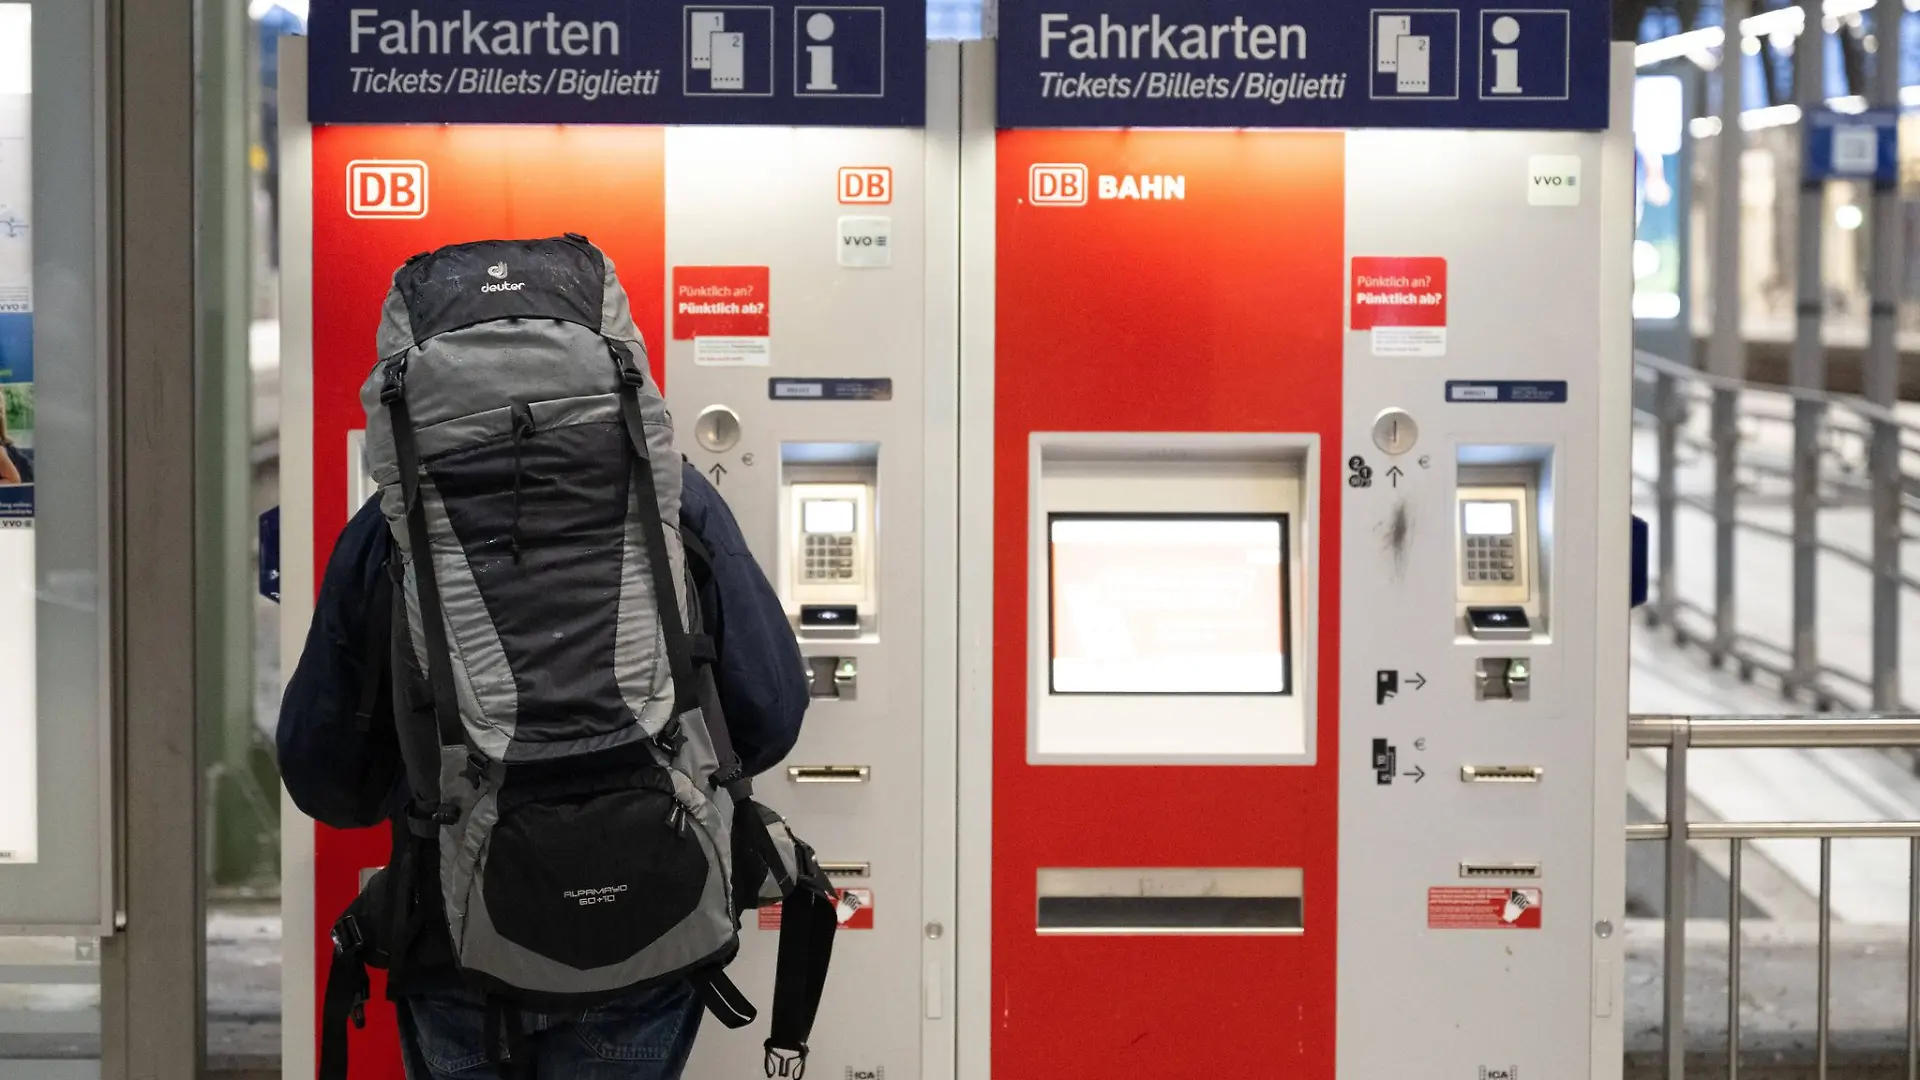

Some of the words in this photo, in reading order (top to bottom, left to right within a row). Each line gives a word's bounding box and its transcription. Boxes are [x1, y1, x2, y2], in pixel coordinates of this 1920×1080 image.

[350, 9, 619, 55] Fahrkarten
[1040, 13, 1307, 59] Fahrkarten
[845, 173, 885, 198] DB
[1039, 173, 1078, 197] DB
[1098, 175, 1185, 200] BAHN
[1534, 176, 1562, 186] VVO
[360, 172, 416, 207] DB
[844, 236, 872, 246] VVO
[481, 281, 525, 293] deuter
[1357, 276, 1409, 287] Pünktlich
[1411, 276, 1431, 287] an?
[679, 286, 732, 297] Pünktlich
[733, 286, 753, 297] an?
[1356, 293, 1417, 304] Pünktlich
[1419, 293, 1442, 304] ab?
[679, 302, 740, 314] Pünktlich
[741, 302, 764, 314] ab?
[563, 884, 628, 897] ALPAMAYO
